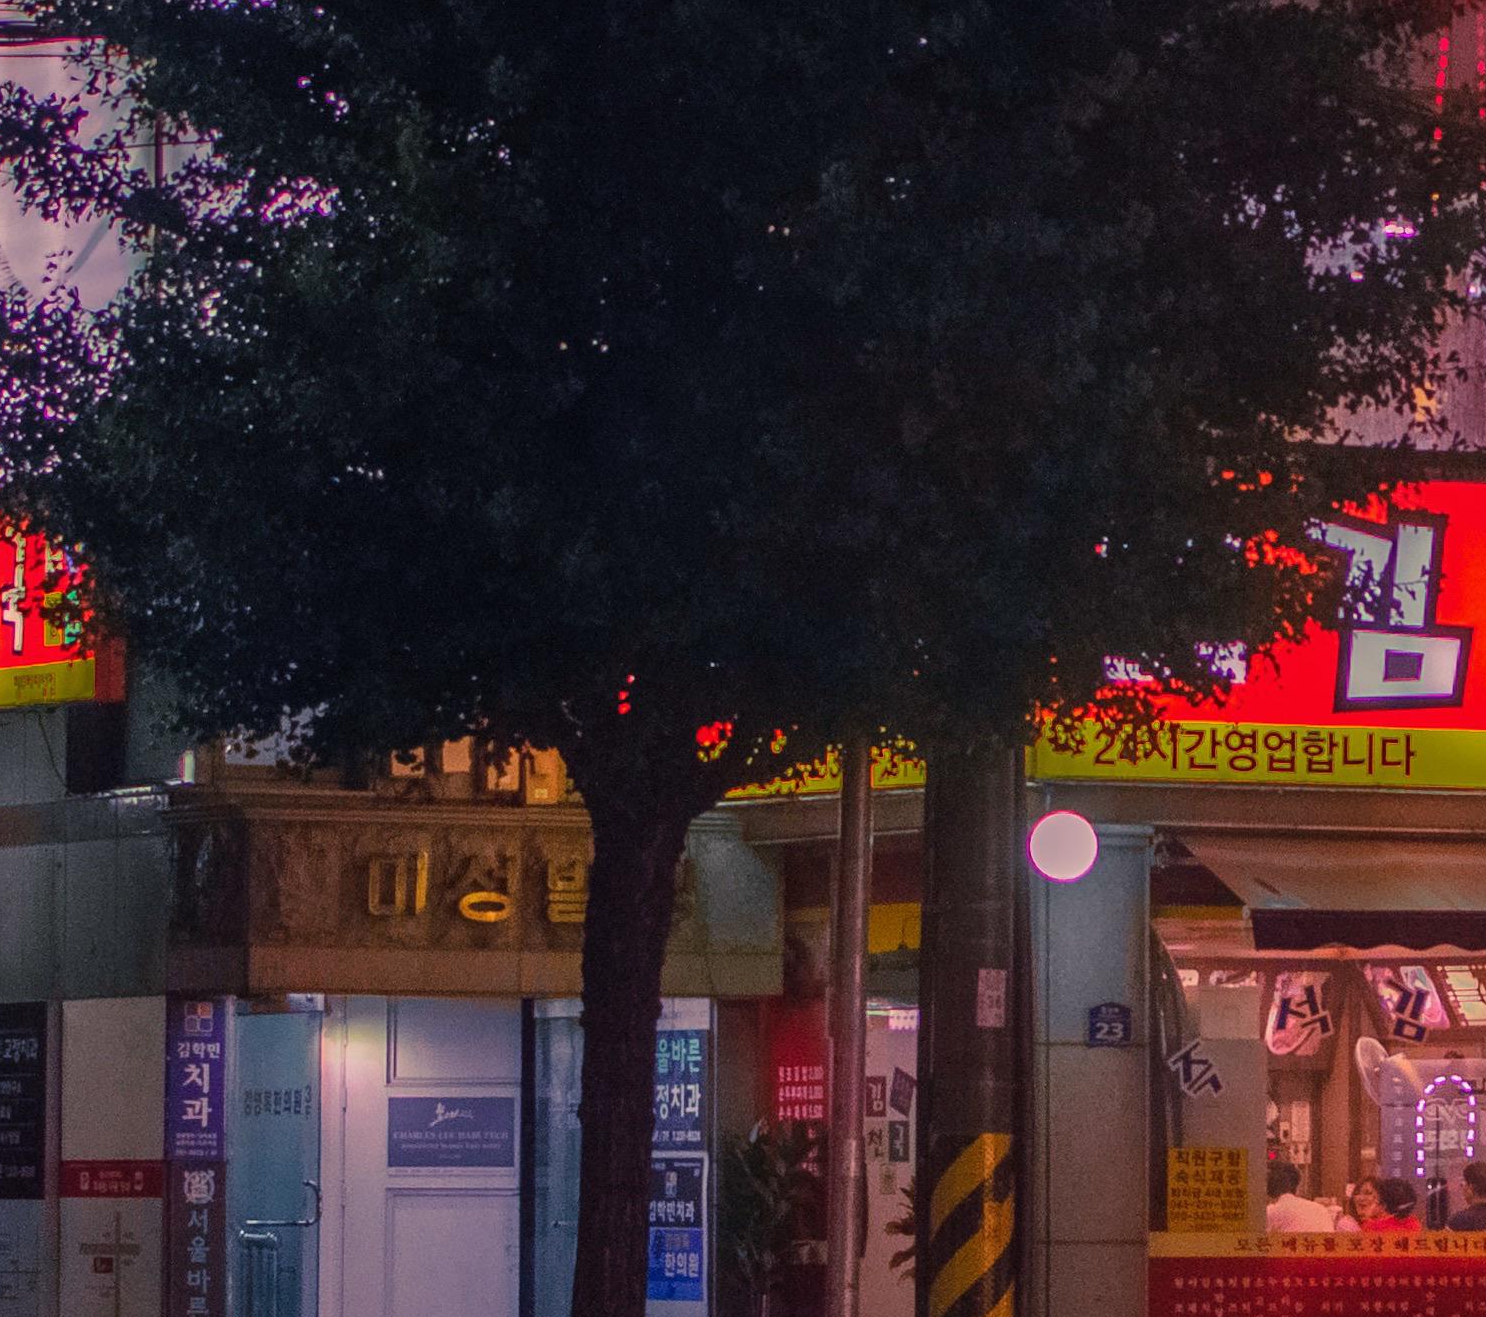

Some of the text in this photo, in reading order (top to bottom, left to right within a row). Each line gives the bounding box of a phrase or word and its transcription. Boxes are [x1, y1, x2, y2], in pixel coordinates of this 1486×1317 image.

[1095, 1021, 1124, 1041] 23
[181, 1062, 213, 1128] 치과
[655, 1083, 702, 1120] 정치과
